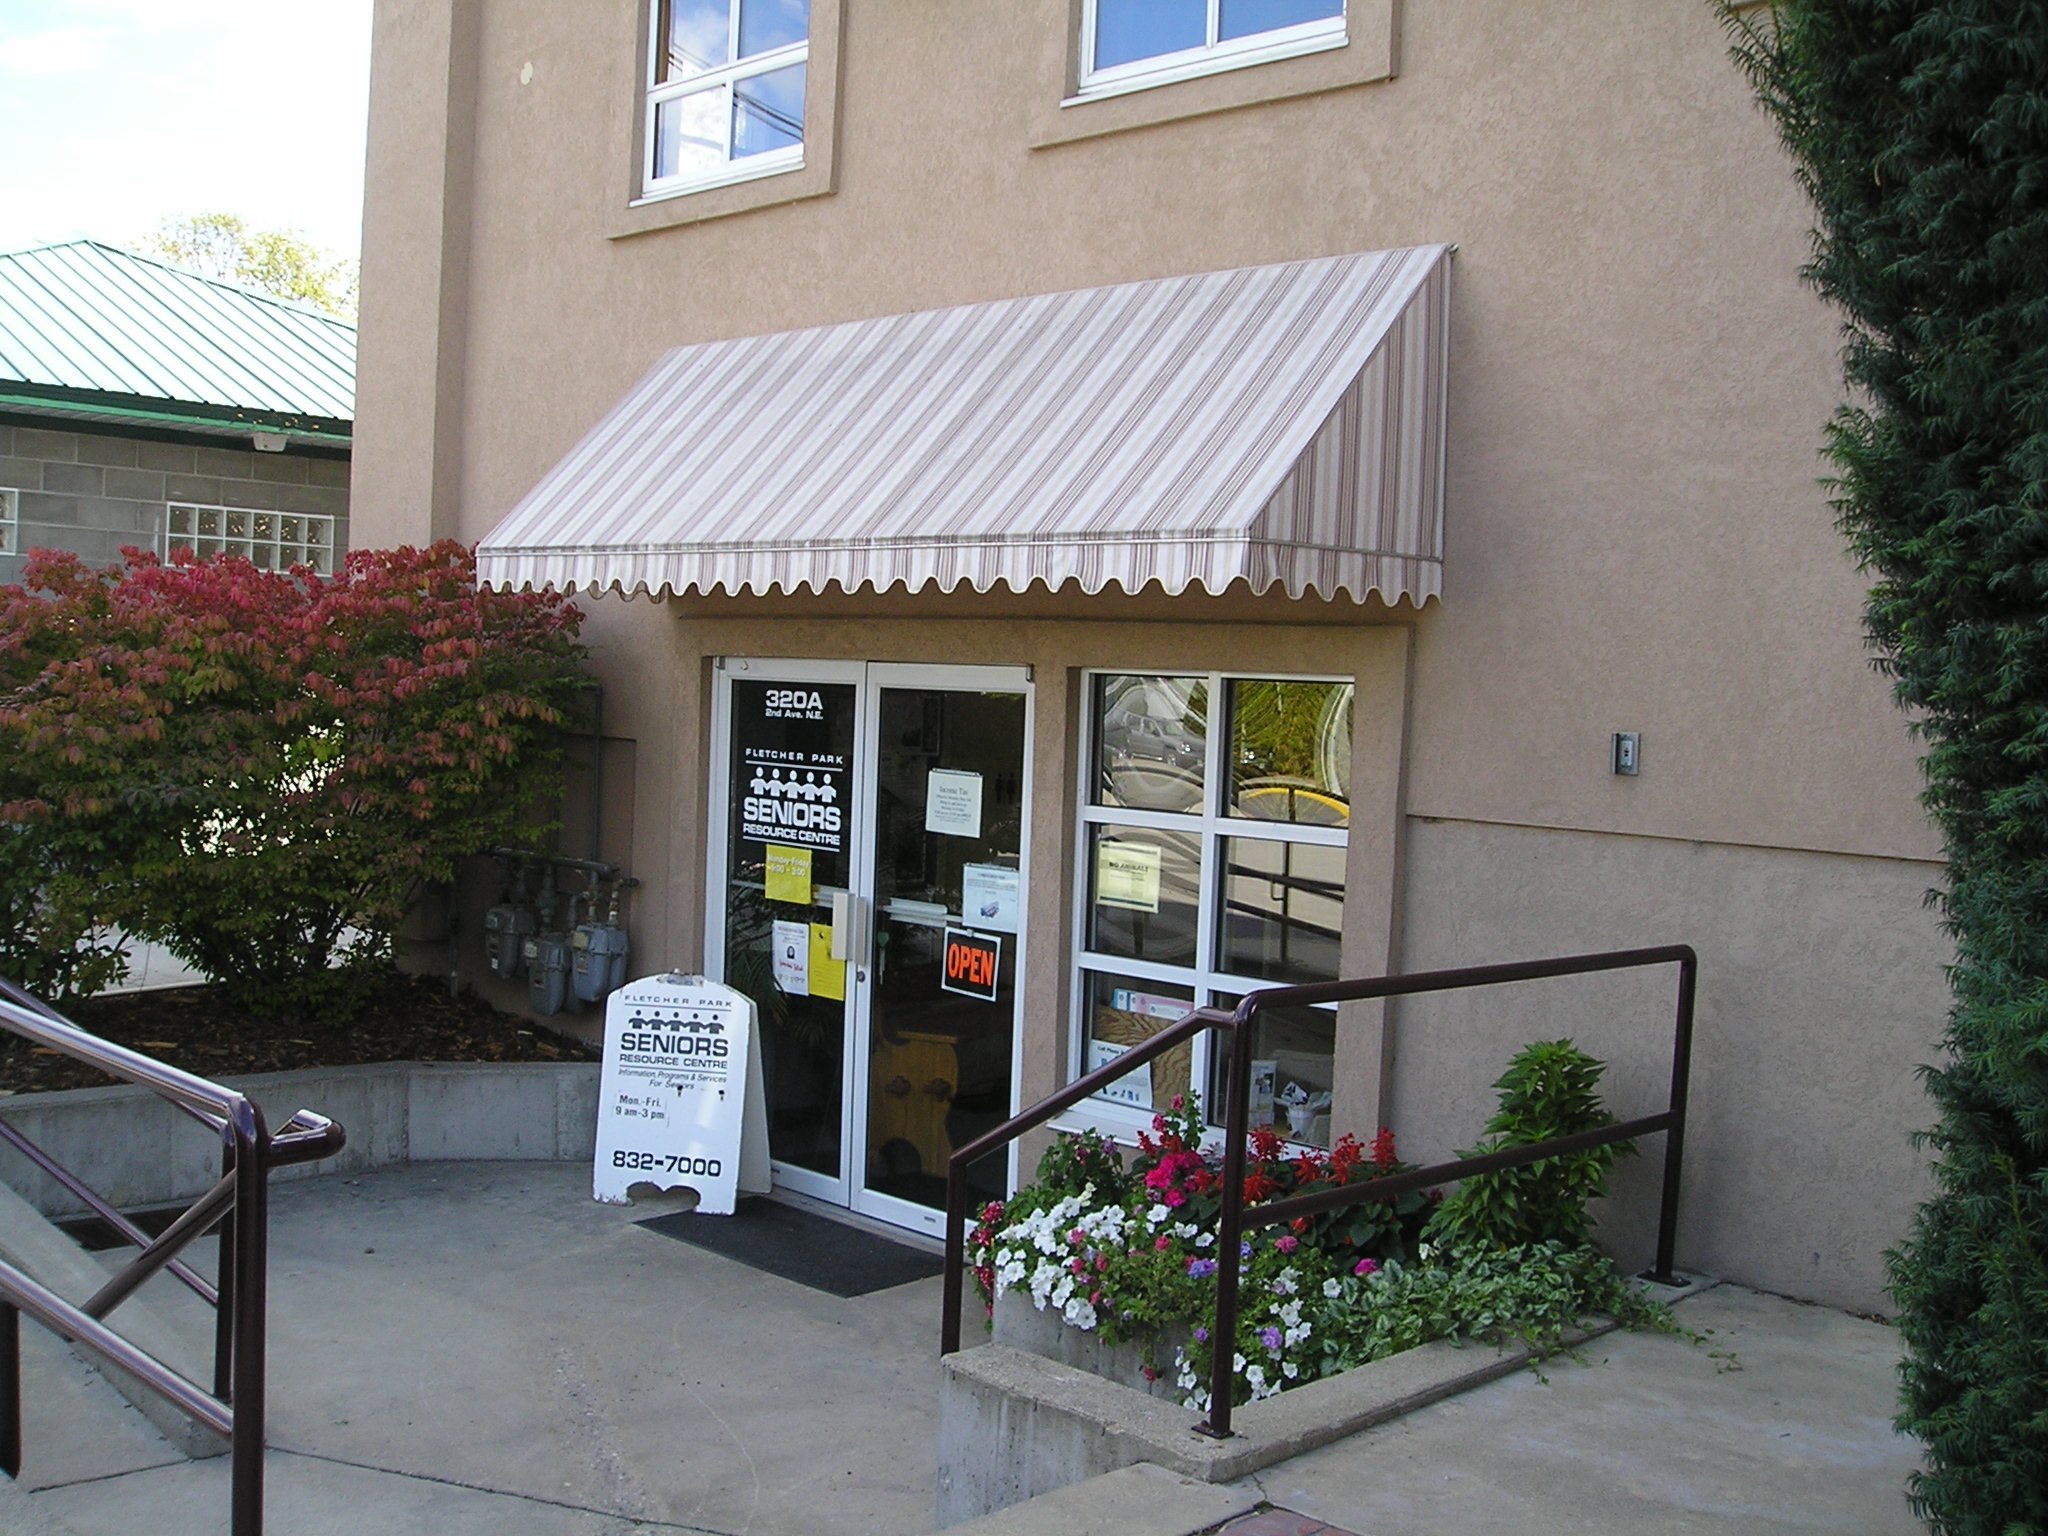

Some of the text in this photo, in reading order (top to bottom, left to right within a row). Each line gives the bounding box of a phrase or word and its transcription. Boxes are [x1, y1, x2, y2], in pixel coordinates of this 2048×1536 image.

[765, 689, 823, 710] 320A
[765, 708, 824, 720] 2nd Ave. N.E.
[745, 748, 843, 764] FLETCHER PARK
[743, 796, 842, 832] SENIORS
[743, 823, 841, 846] RESOURCE CENTRE
[948, 943, 994, 987] OPEN
[625, 994, 732, 1008] FLETCHER PARK
[620, 1032, 729, 1058] SENIORS
[619, 1053, 728, 1070] RESOURCE CENTRE
[649, 1079, 662, 1087] For
[658, 1070, 689, 1081] Programs
[691, 1072, 695, 1081] &
[697, 1073, 727, 1084] Services
[615, 1106, 622, 1115] 9
[651, 1111, 665, 1120] pm
[613, 1150, 722, 1178] 832-7000
